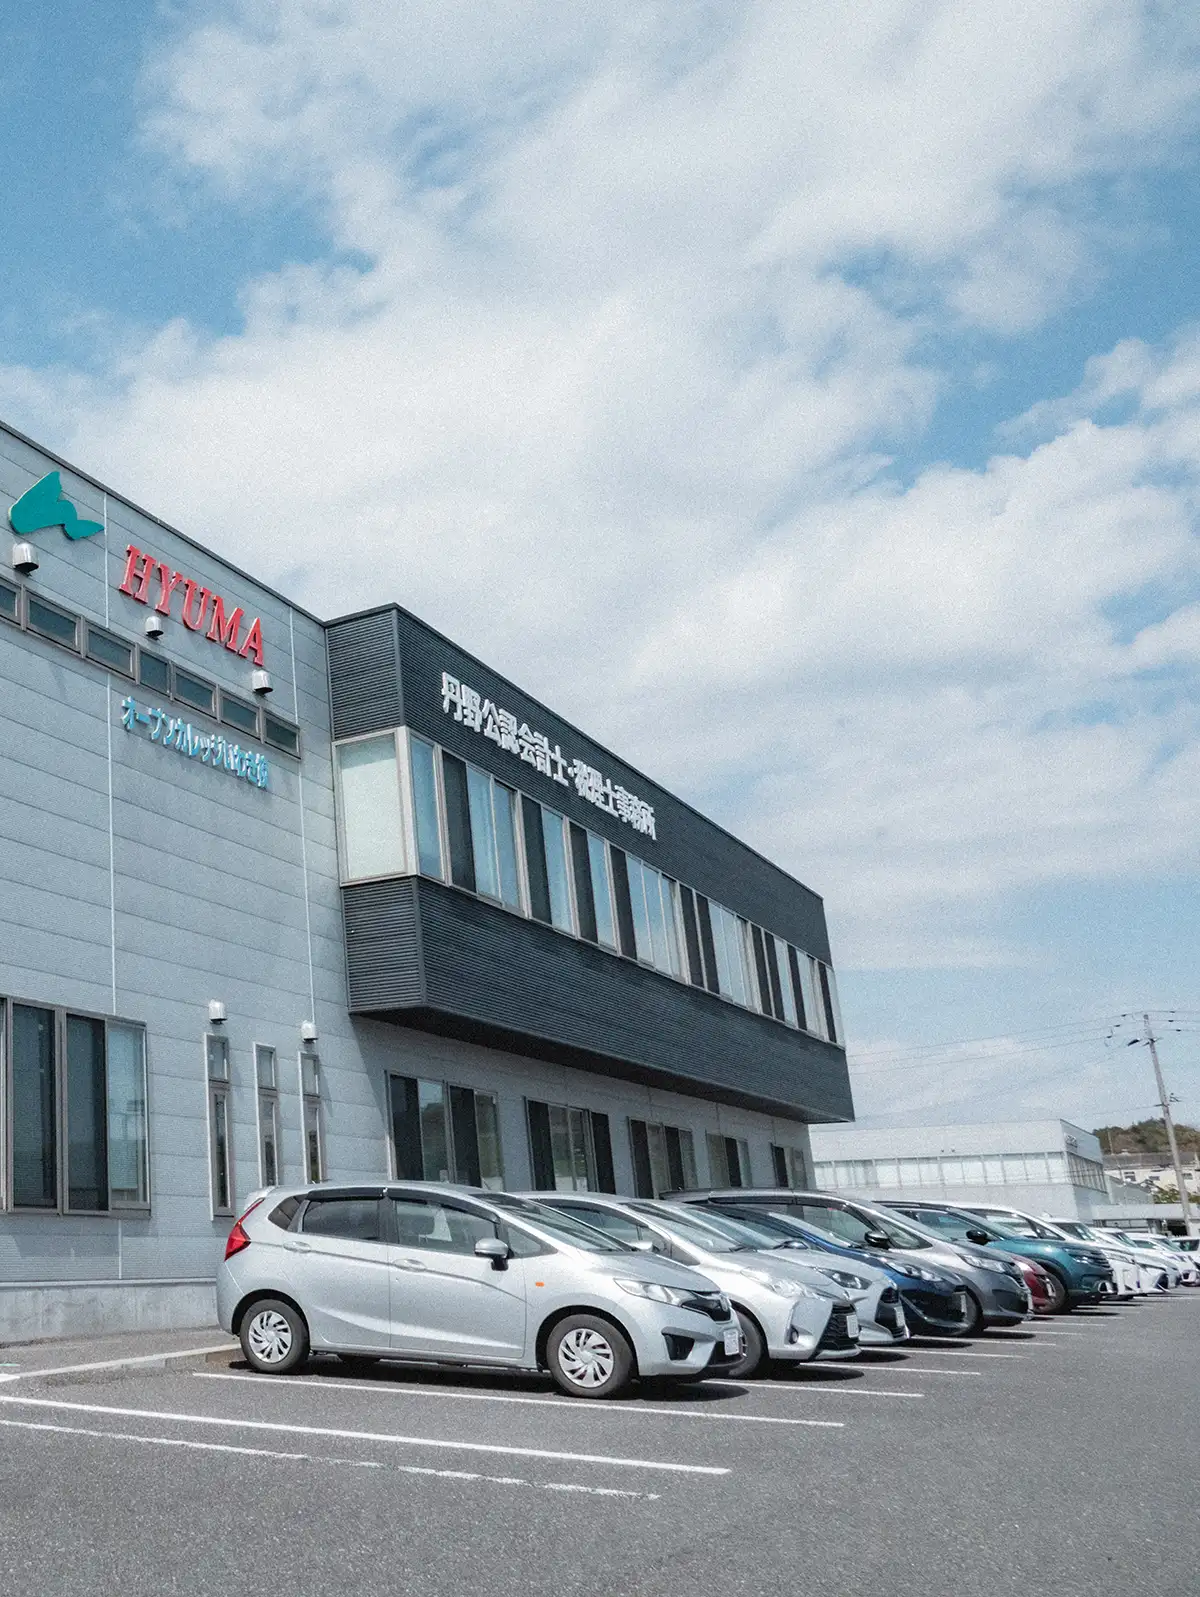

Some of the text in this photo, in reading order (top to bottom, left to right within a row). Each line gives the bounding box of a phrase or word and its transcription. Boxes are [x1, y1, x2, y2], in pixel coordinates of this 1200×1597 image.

[119, 544, 265, 667] HYUMA
[441, 671, 657, 841] 丹野公認会計士・税理士事務所
